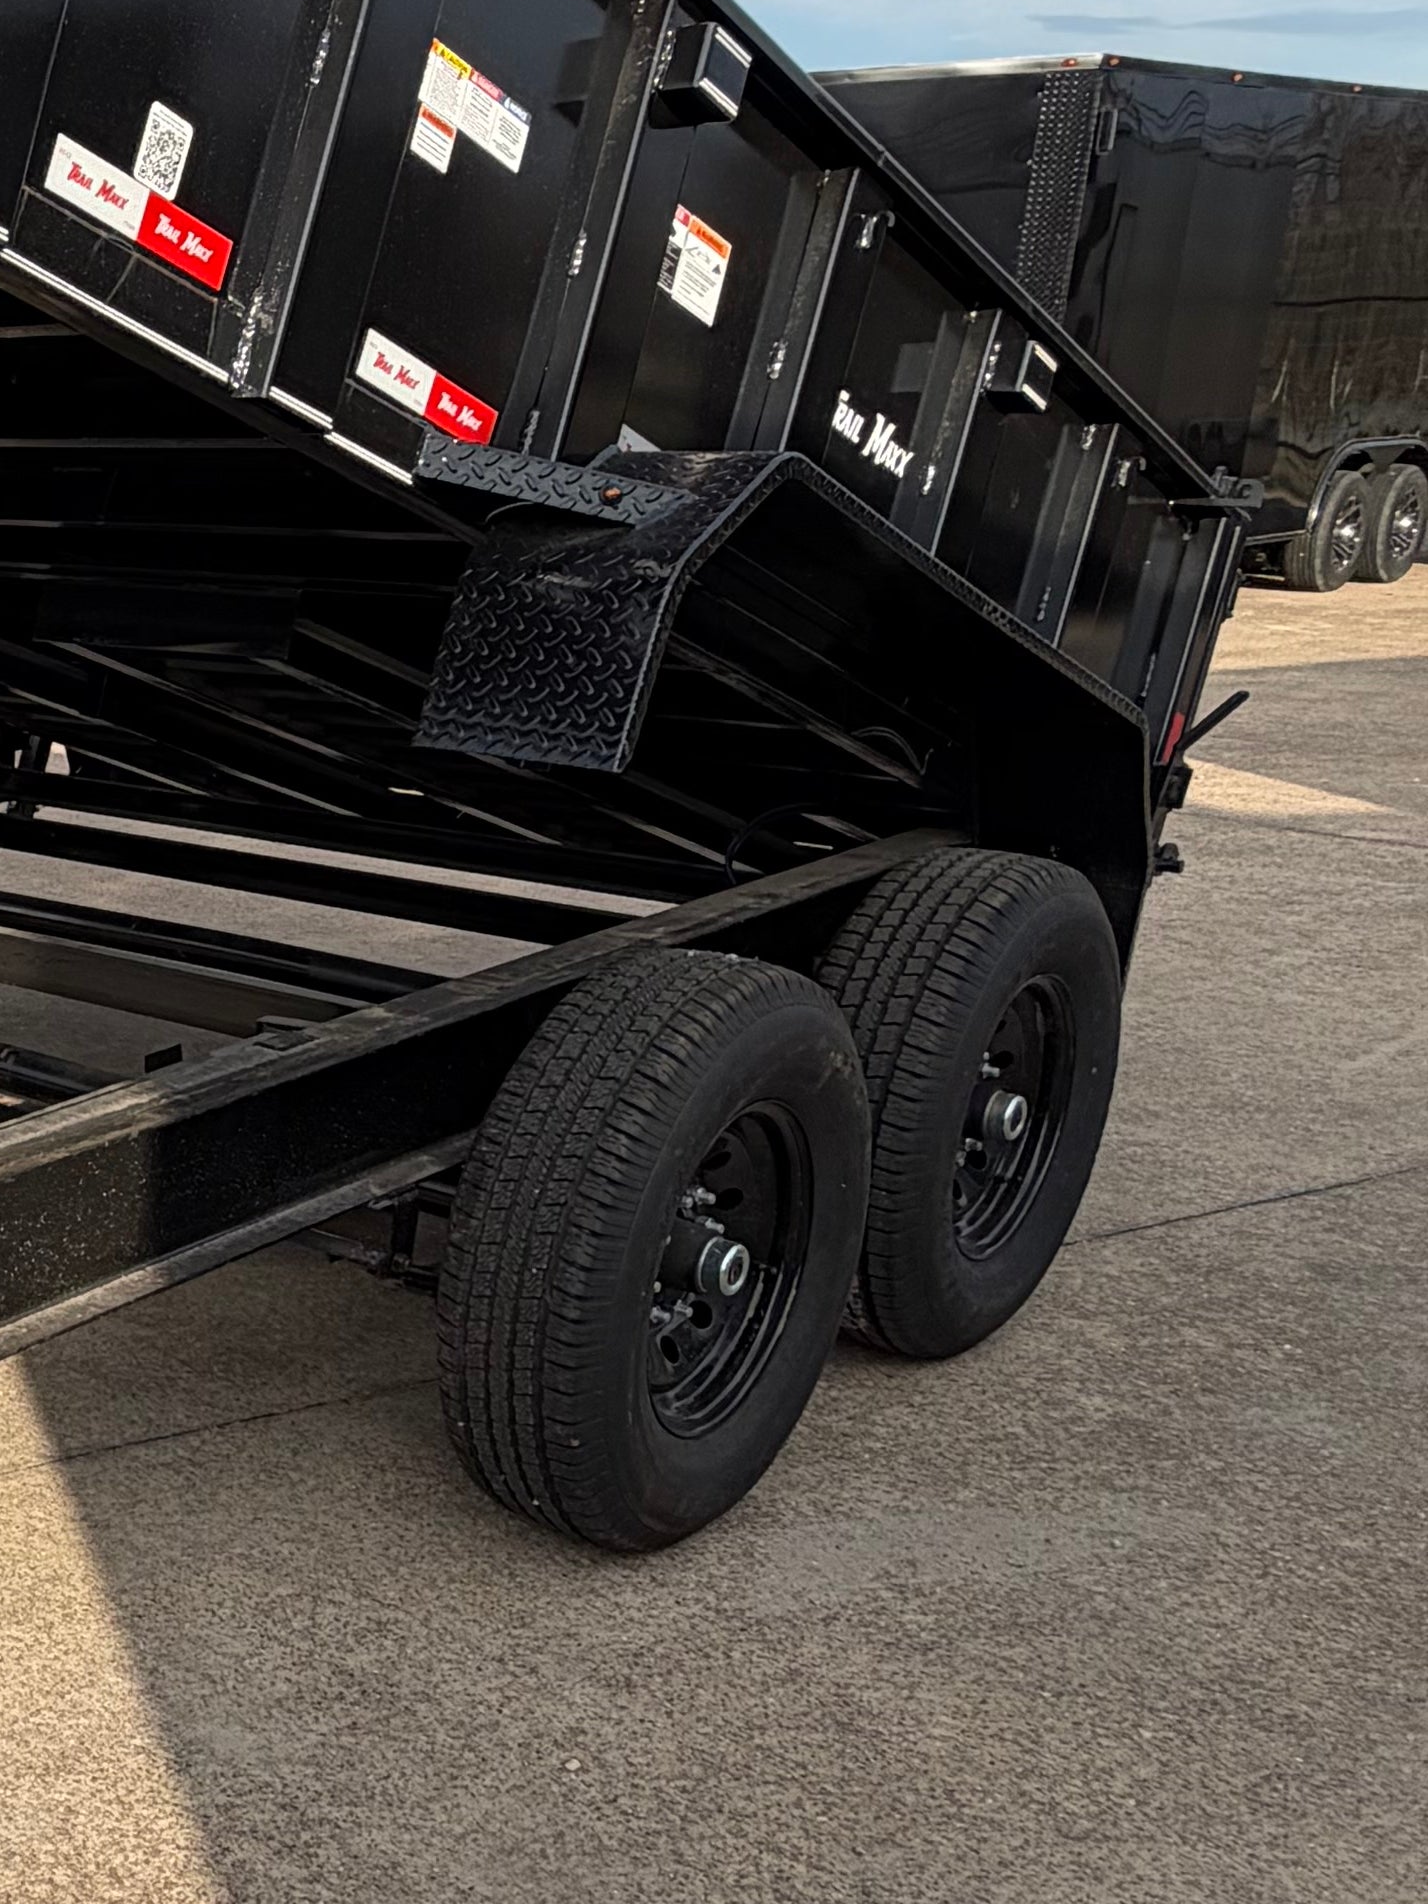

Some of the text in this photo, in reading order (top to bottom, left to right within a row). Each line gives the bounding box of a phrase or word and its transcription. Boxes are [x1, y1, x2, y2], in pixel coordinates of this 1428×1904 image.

[67, 161, 129, 210] TRAIL MAXX
[154, 213, 214, 263] TRAIL MAXX
[861, 412, 915, 478] MAXX
